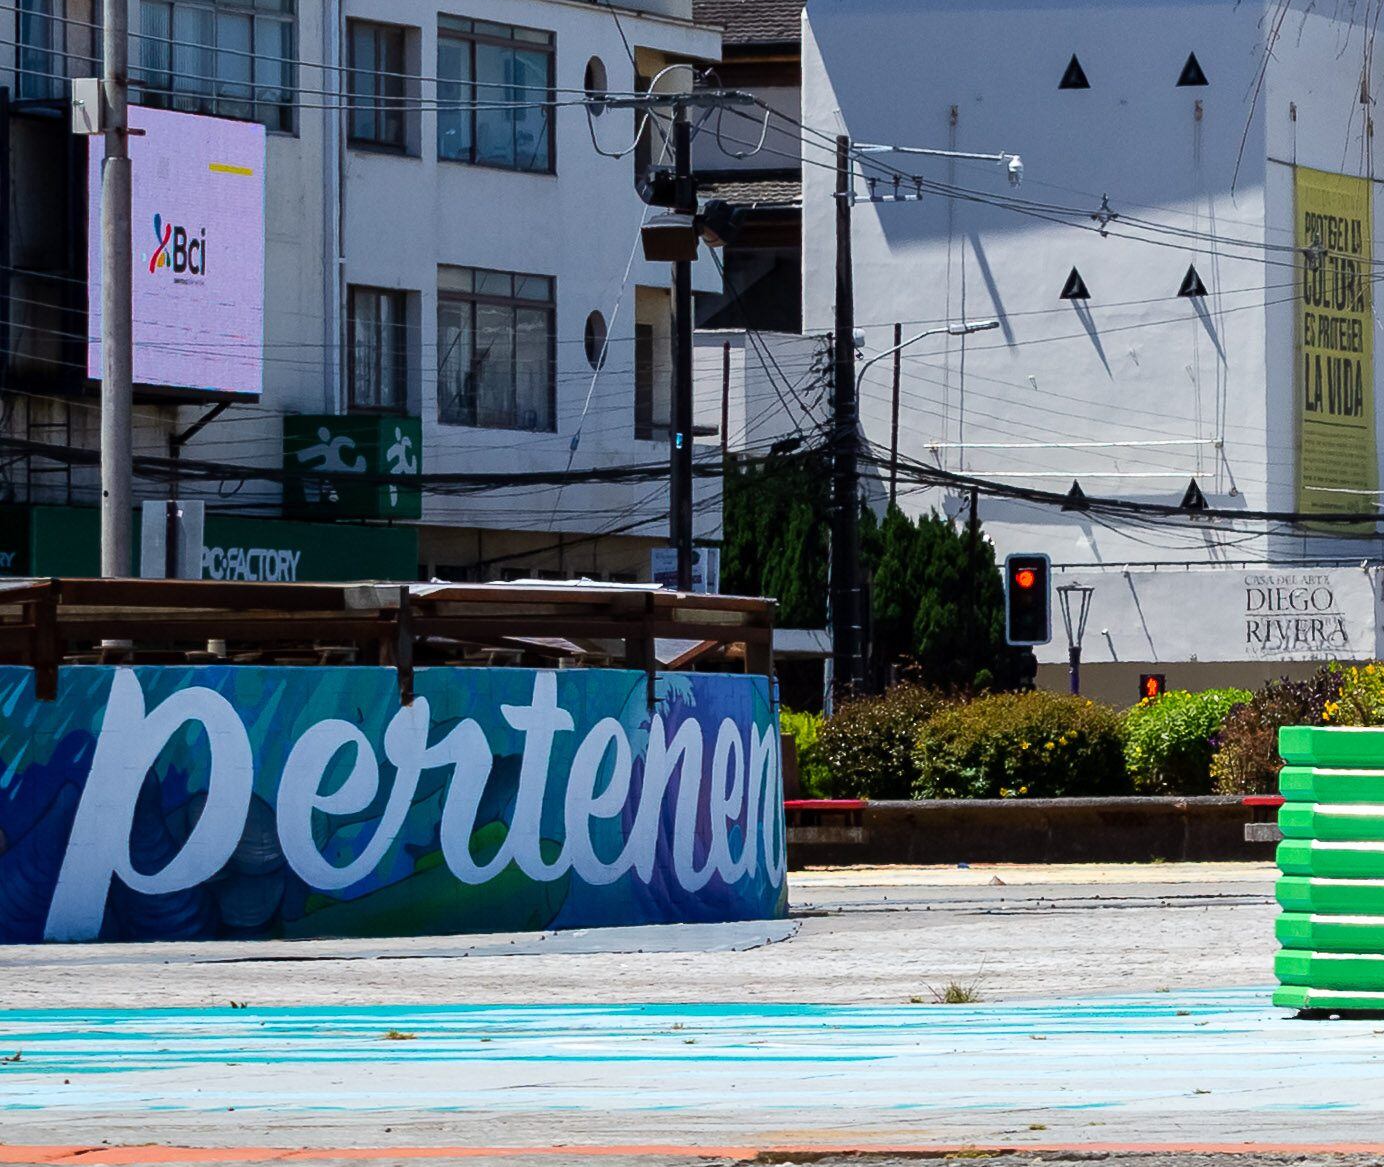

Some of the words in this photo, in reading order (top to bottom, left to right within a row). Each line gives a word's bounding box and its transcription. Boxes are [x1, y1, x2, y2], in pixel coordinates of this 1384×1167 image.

[174, 226, 206, 276] Bci
[1305, 353, 1323, 413] LA
[1327, 355, 1363, 417] VIDA
[1246, 587, 1333, 611] DIEGO
[1246, 618, 1349, 643] RIVERA
